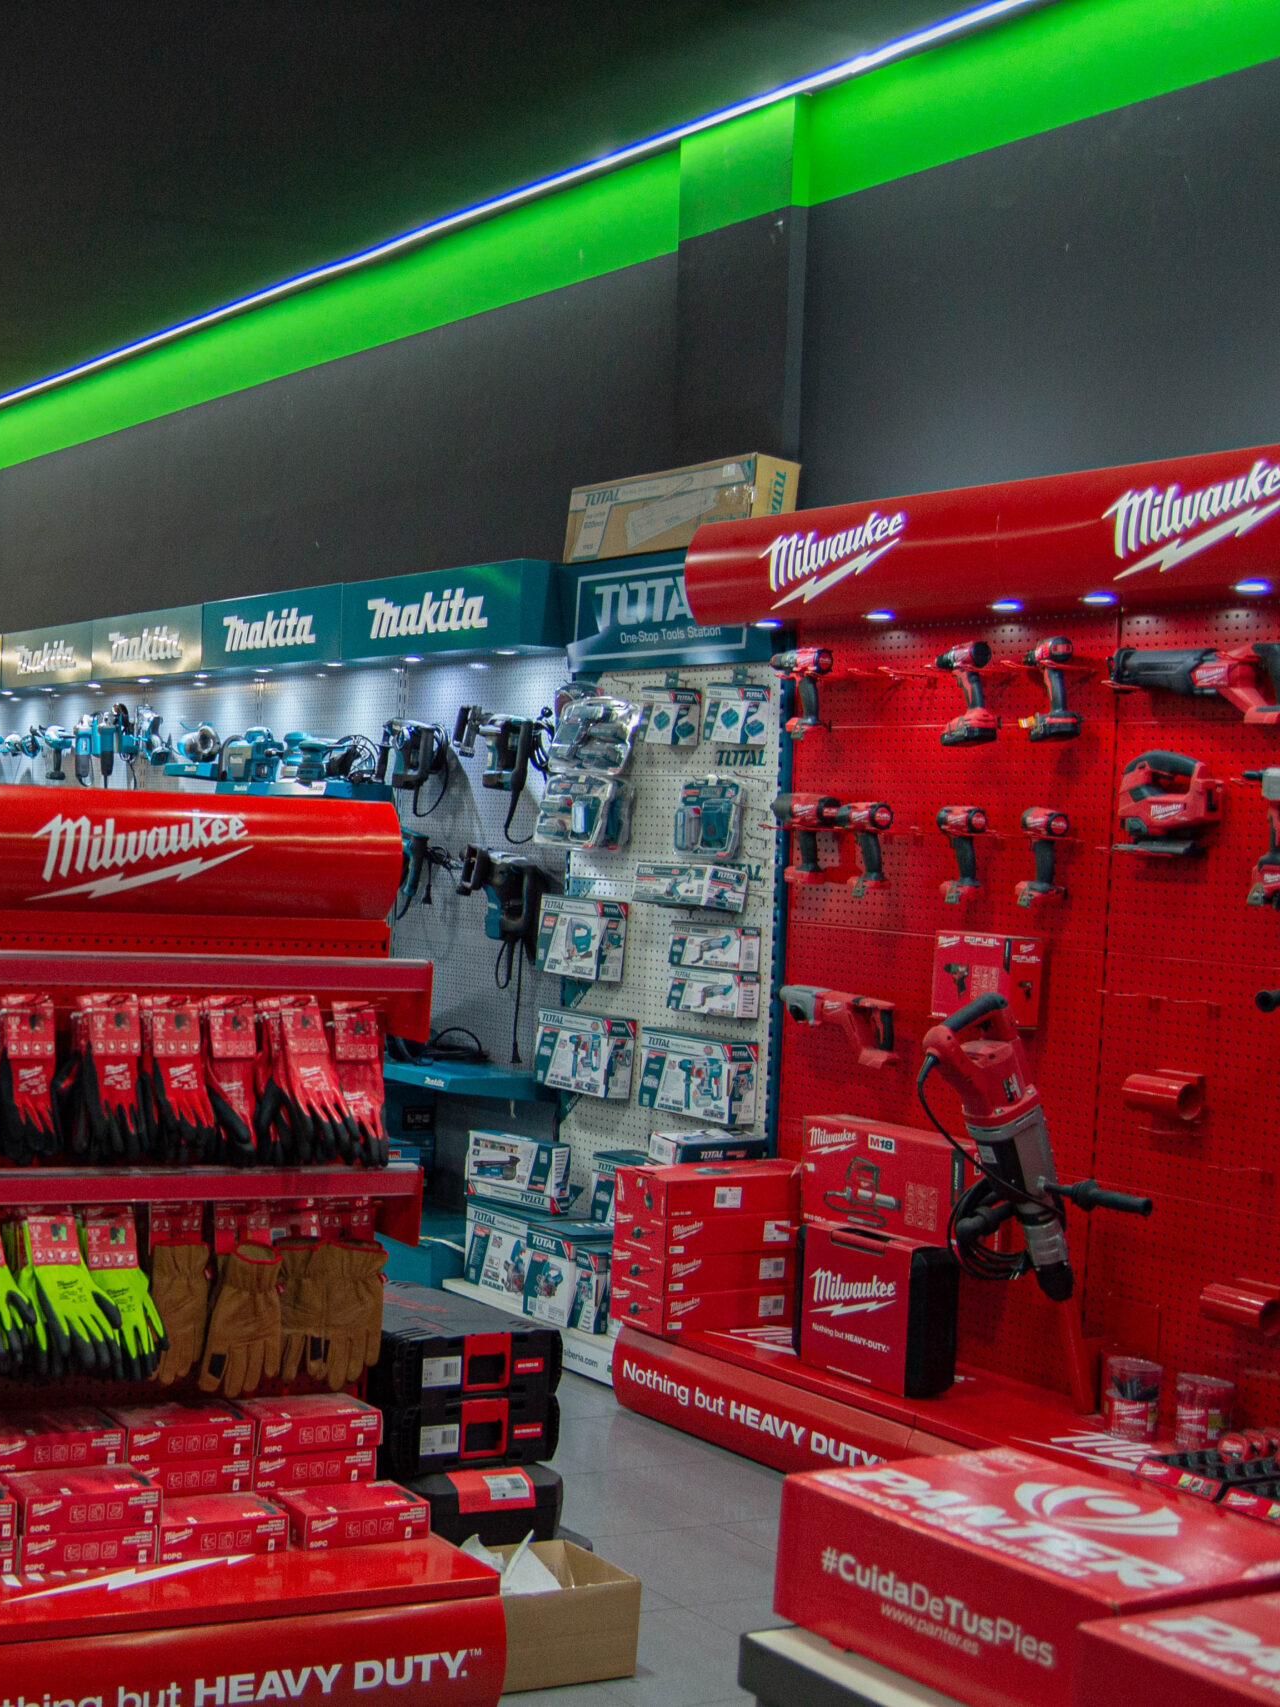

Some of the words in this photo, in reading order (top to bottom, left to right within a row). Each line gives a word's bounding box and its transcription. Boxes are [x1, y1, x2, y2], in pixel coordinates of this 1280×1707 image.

[585, 488, 620, 507] TOTAL
[771, 470, 787, 514] TOTA
[1103, 460, 1280, 558] Milwauke
[760, 510, 905, 593] Milwaukee
[367, 588, 488, 639] Makita
[595, 575, 693, 631] TOTA
[223, 608, 316, 652] Makita
[620, 629, 659, 644] One-Stop
[662, 628, 685, 641] Tools
[687, 625, 722, 639] Station
[109, 626, 184, 665] Makita
[716, 749, 767, 768] TOTAL
[32, 811, 249, 884] Milwaukee
[543, 900, 565, 911] TOTAL
[542, 1013, 564, 1025] TOTAL
[648, 1036, 671, 1048] TOTAL
[808, 1126, 857, 1147] Milwaukee
[869, 1136, 894, 1151] M18
[597, 1162, 616, 1172] TOTA
[700, 1151, 724, 1159] TOTAL
[521, 1193, 546, 1206] TOTAL
[473, 1210, 496, 1225] TOTAL
[532, 1237, 556, 1249] TOTAL
[809, 1267, 897, 1303] Milwaukee
[812, 1322, 834, 1338] Nothing
[835, 1329, 845, 1339] but
[562, 1348, 599, 1369] siberia.com
[623, 1359, 690, 1406] Nothing
[695, 1387, 725, 1416] but
[729, 1400, 806, 1446] HEAVY
[821, 1547, 1055, 1668] #CuidaDeTusPies
[880, 1602, 981, 1656] www.panter.es
[117, 1682, 182, 1707] but
[194, 1664, 343, 1707] HEAVY
